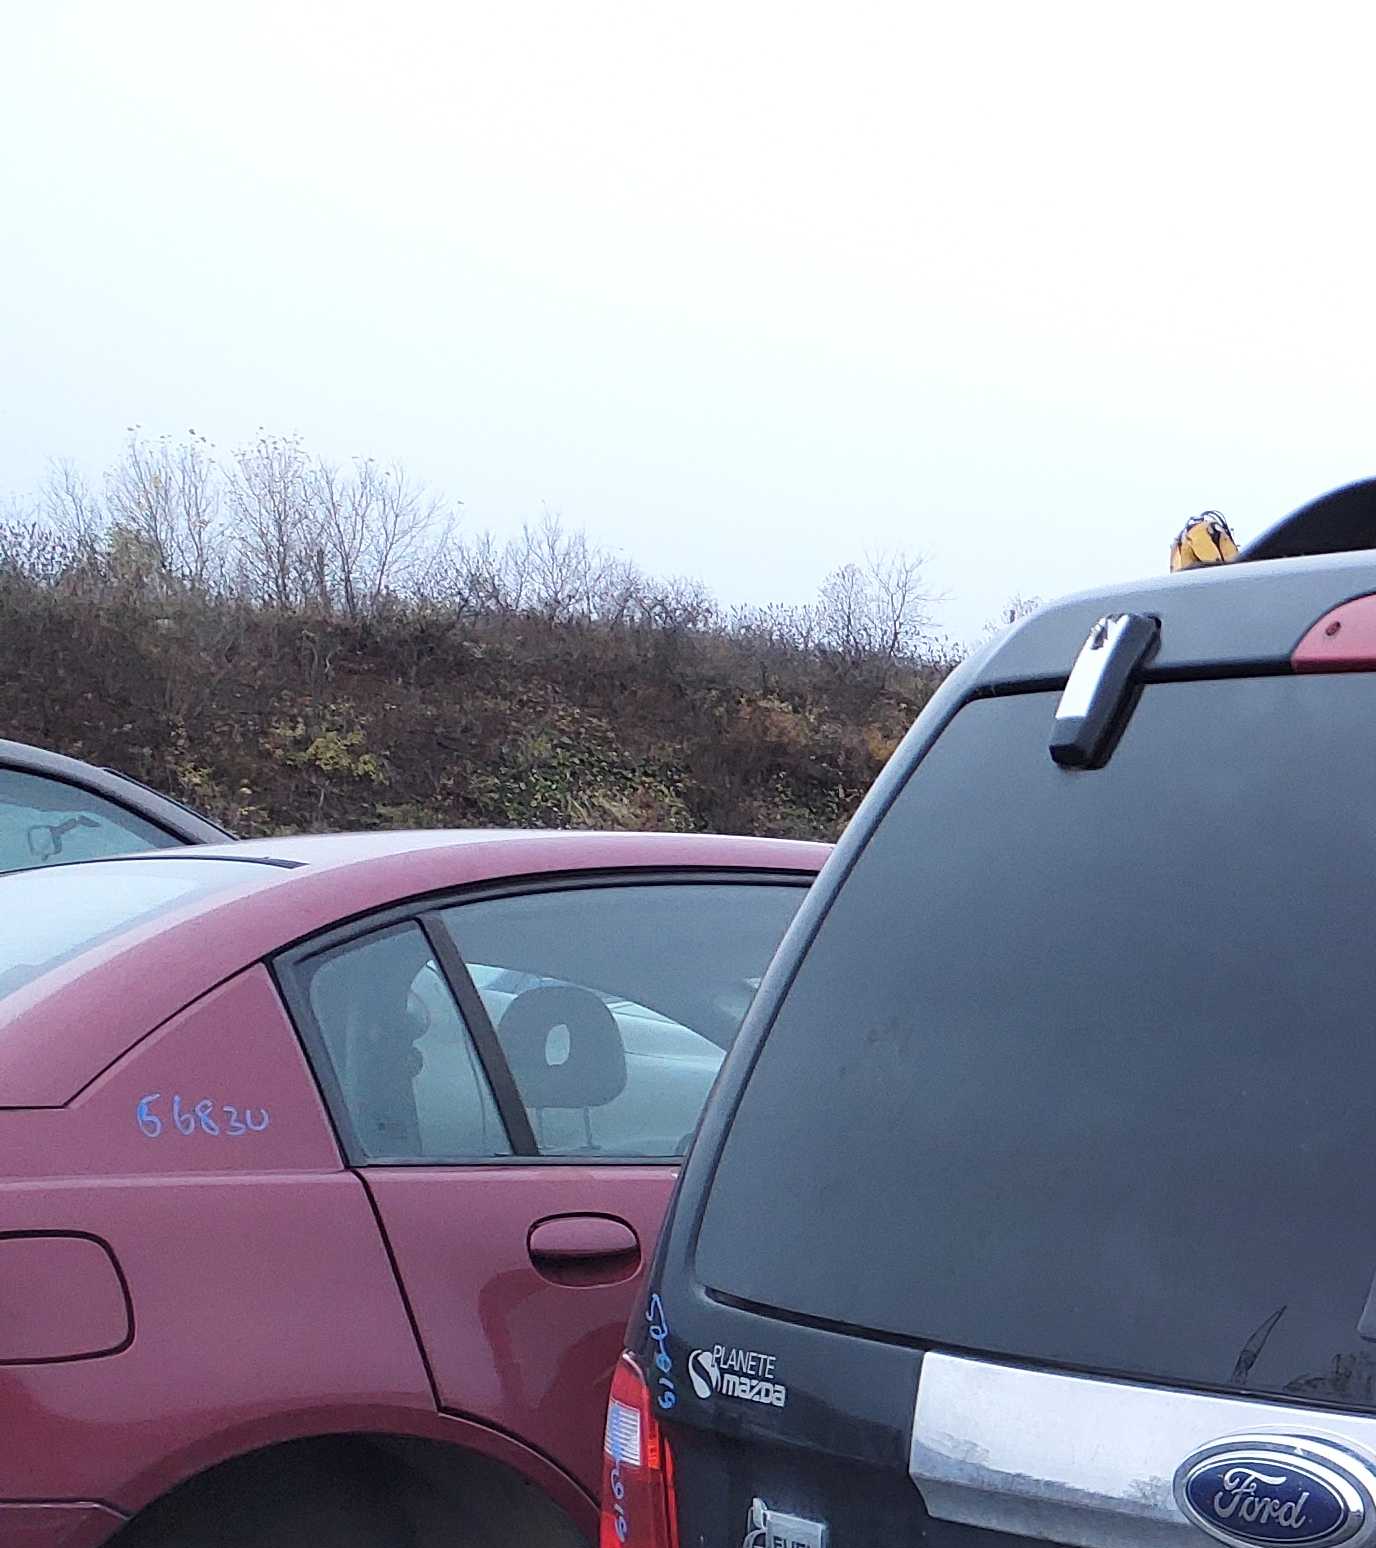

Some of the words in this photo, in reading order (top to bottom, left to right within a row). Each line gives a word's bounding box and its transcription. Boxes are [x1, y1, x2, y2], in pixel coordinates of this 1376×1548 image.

[711, 1344, 777, 1379] PLANETE
[721, 1373, 787, 1408] mazda
[1214, 1467, 1310, 1529] Ford
